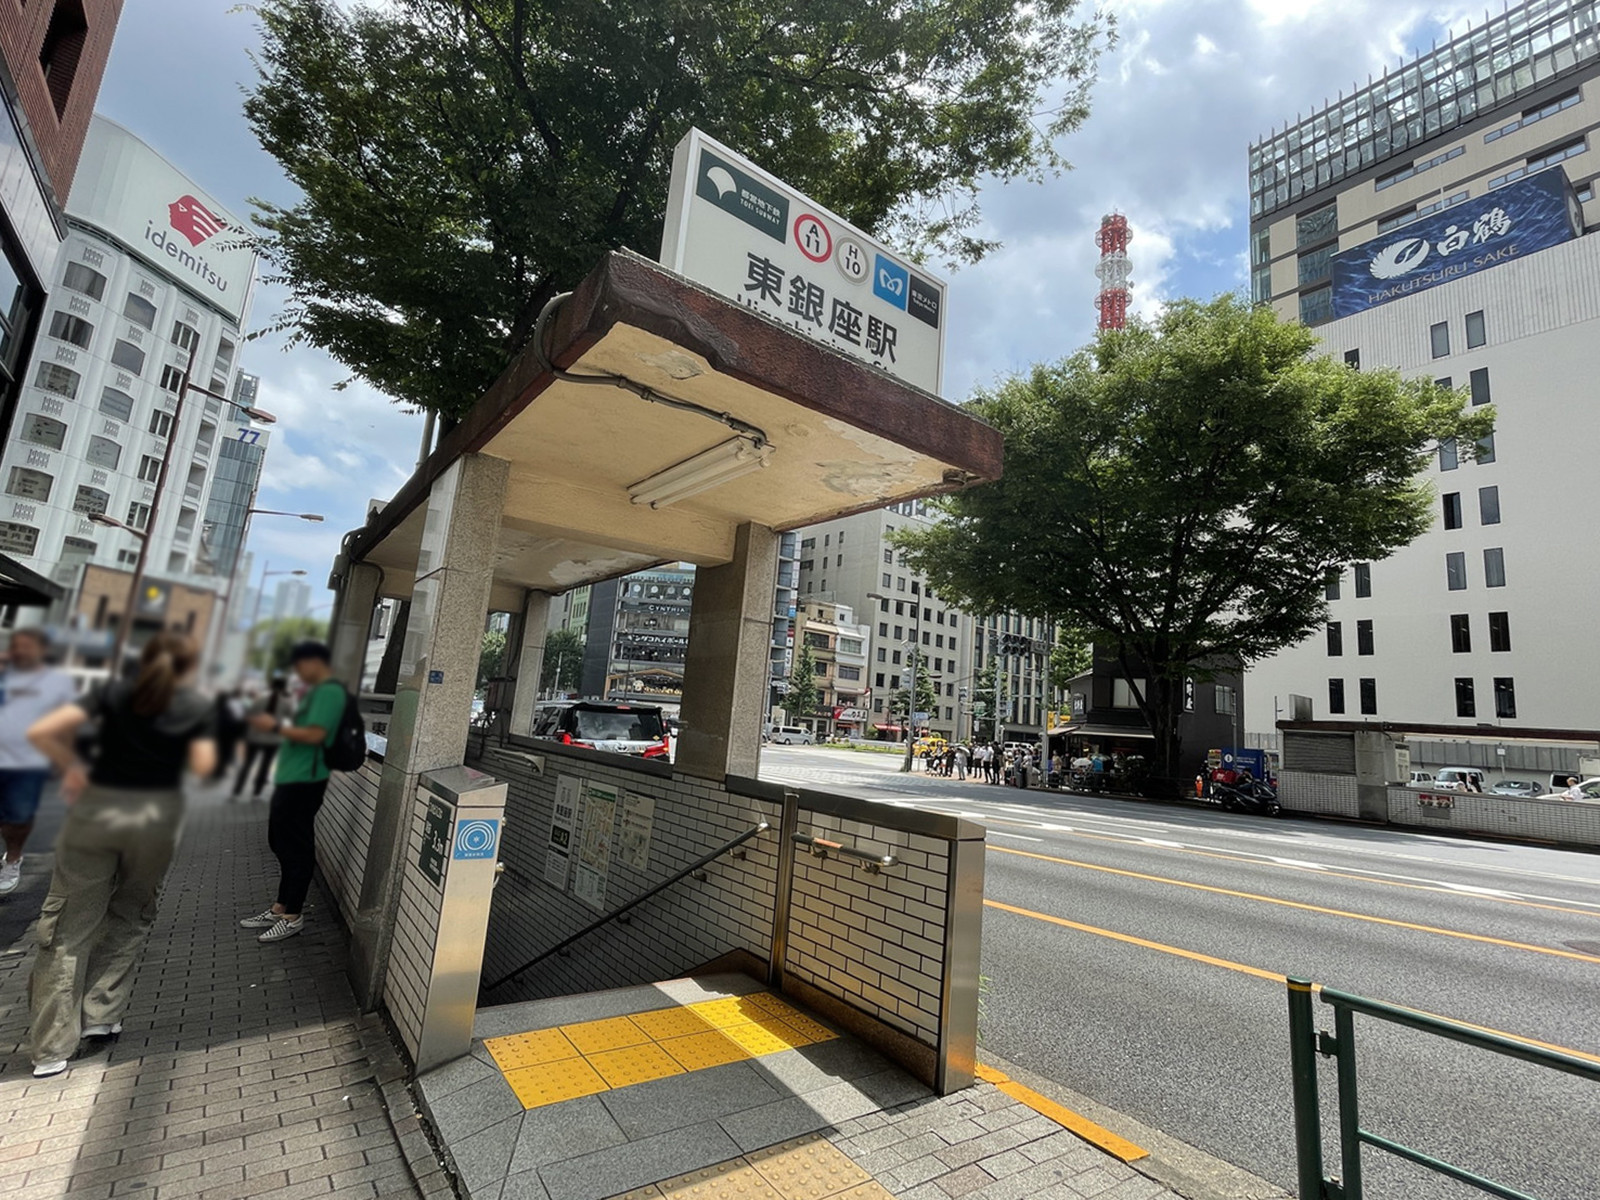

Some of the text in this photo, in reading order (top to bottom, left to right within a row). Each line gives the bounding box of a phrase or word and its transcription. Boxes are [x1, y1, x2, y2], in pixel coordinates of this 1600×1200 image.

[755, 207, 781, 225] SUBWAY
[808, 223, 820, 238] A
[1436, 206, 1512, 257] 白鶴
[804, 234, 821, 255] 11
[848, 245, 858, 260] H
[144, 220, 228, 292] idemitsu
[845, 259, 861, 276] 10
[1368, 244, 1520, 304] HAKUTSURU SAKE
[744, 252, 897, 364] 東銀座駅
[236, 427, 261, 445] 77
[648, 604, 685, 613] CYNTHIA
